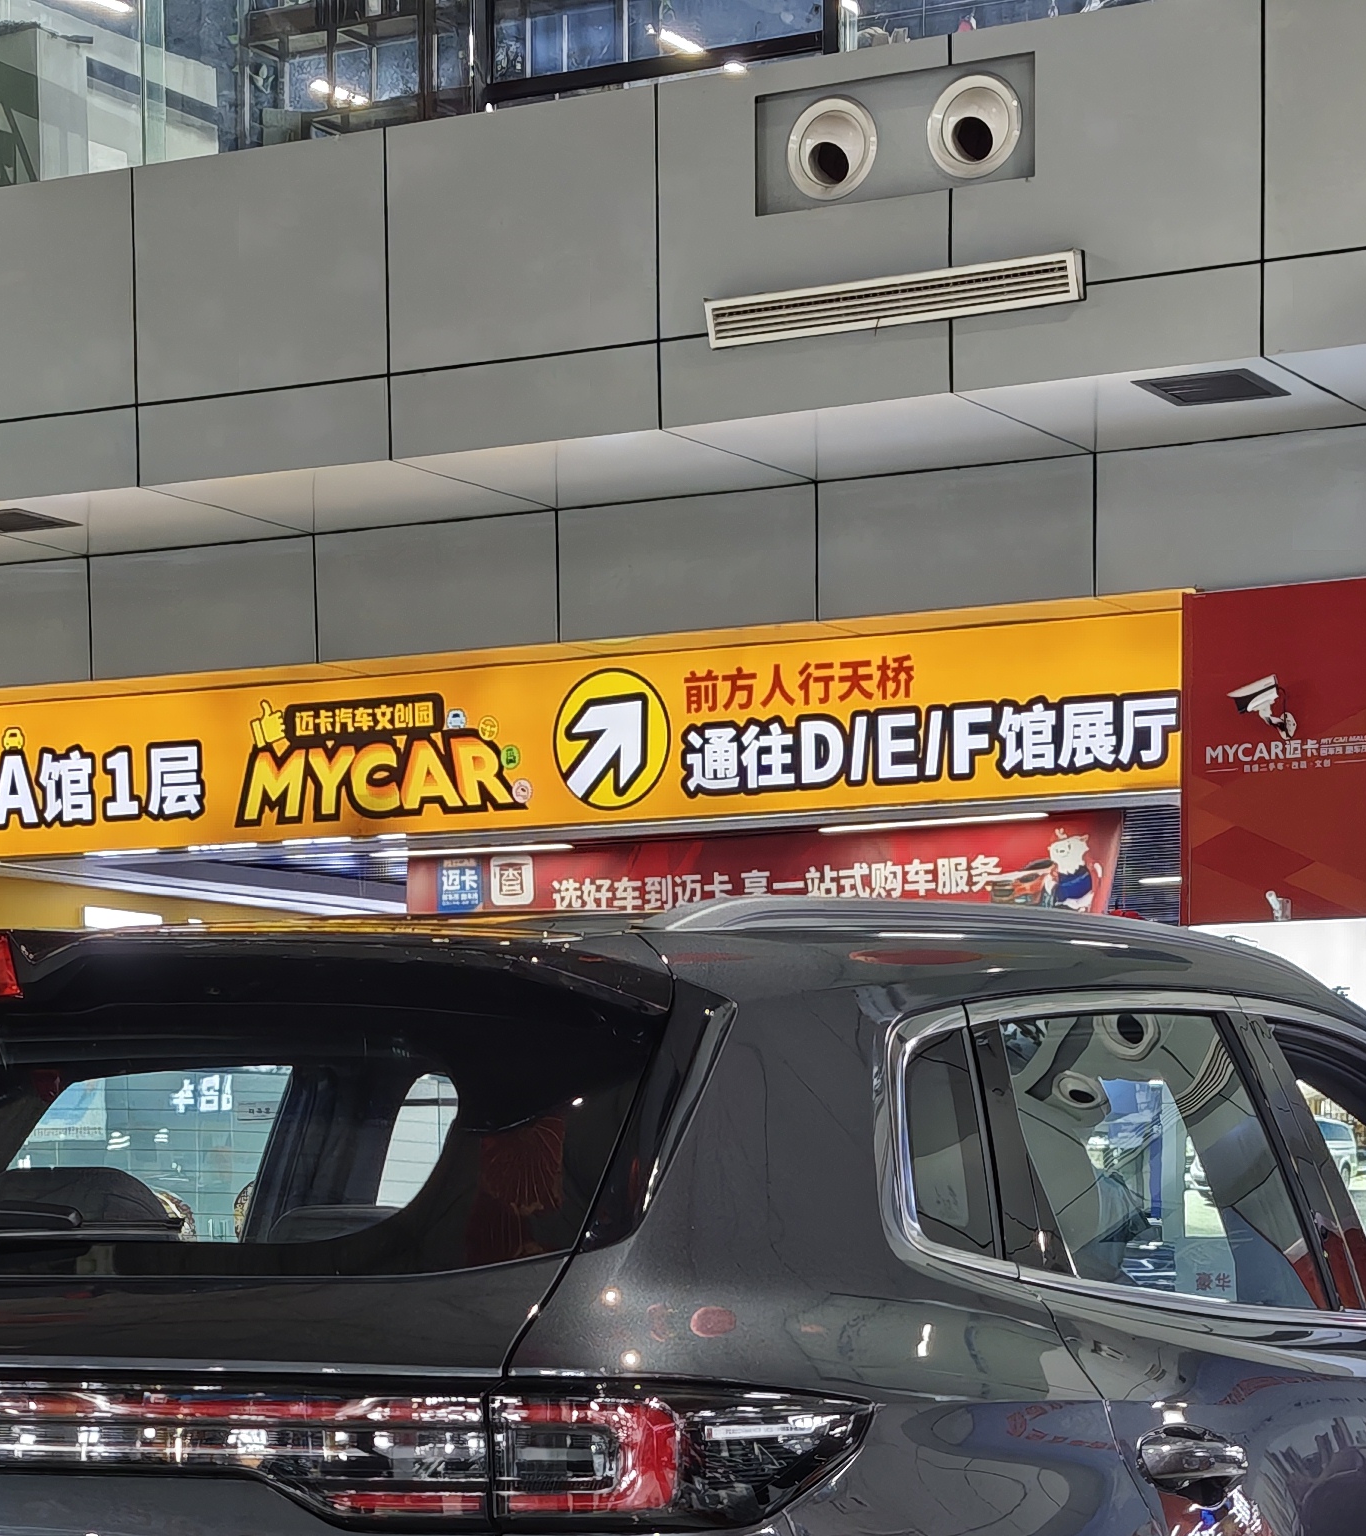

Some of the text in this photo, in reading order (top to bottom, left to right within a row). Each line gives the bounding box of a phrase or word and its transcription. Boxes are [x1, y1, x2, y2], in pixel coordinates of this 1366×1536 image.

[683, 654, 916, 715] 前方人行天桥
[294, 701, 434, 735] 迈卡汽车文创园
[683, 695, 1178, 793] 通往D/E/F馆展厅
[241, 738, 517, 822] MYCAR
[441, 869, 479, 891] 迈卡
[740, 855, 1002, 898] 享一站式购车服务
